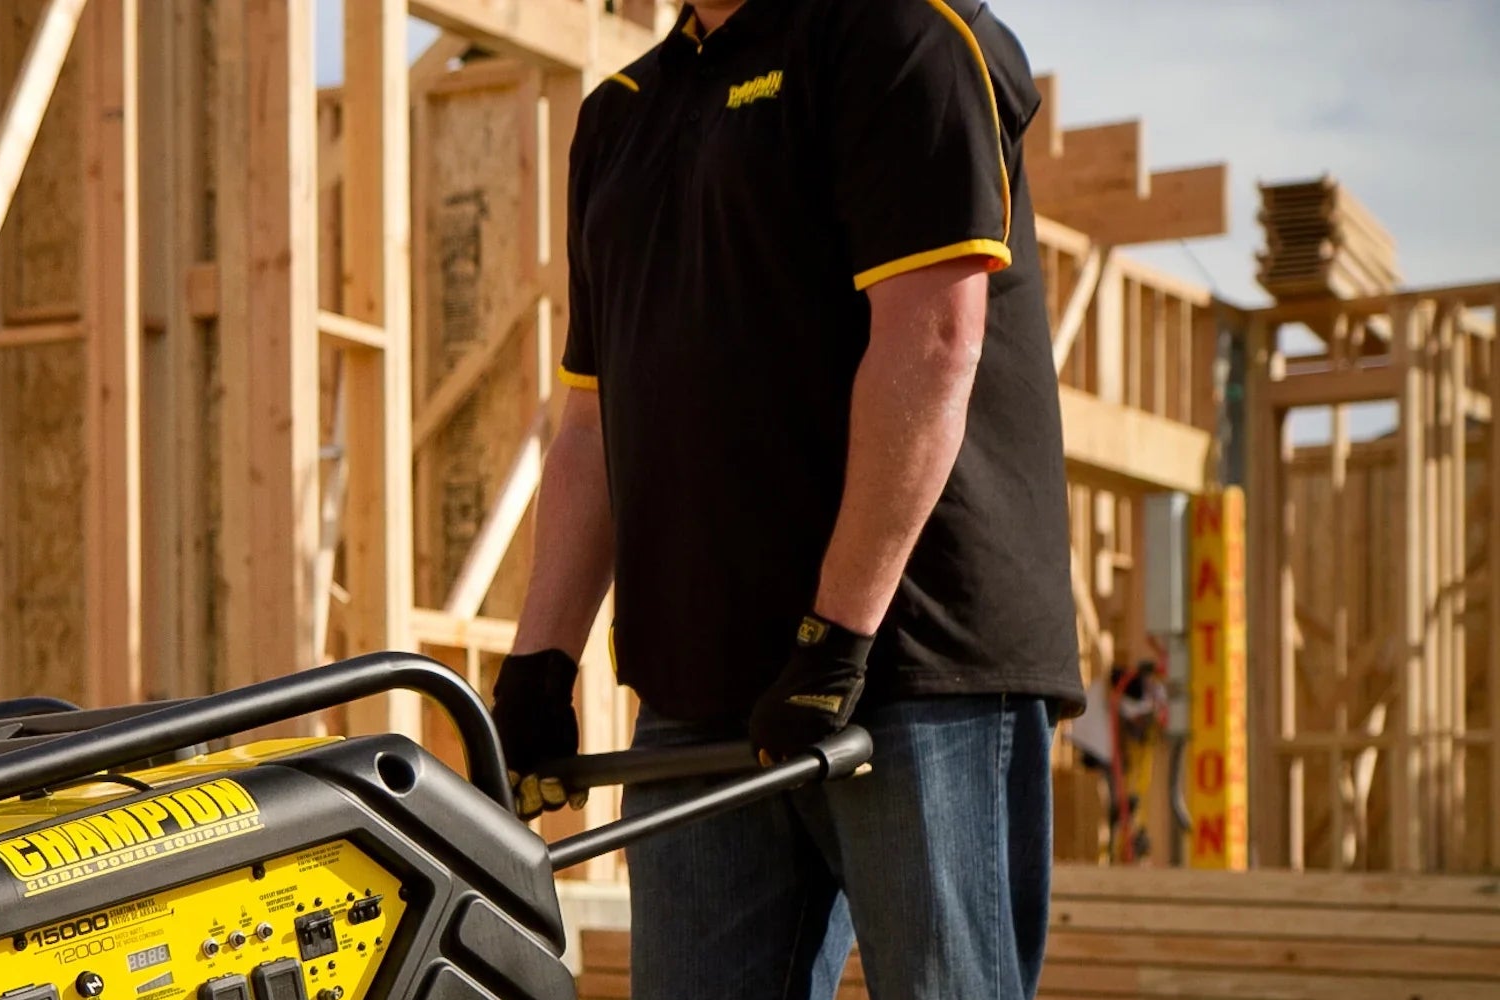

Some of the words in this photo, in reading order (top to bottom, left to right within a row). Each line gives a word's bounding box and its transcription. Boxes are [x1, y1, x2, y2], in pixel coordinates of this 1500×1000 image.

[25, 864, 94, 891] GLOBAL
[97, 846, 157, 871] POWER
[164, 815, 263, 851] EQUIPMENT
[30, 913, 109, 948] 15000
[54, 936, 116, 965] 12000
